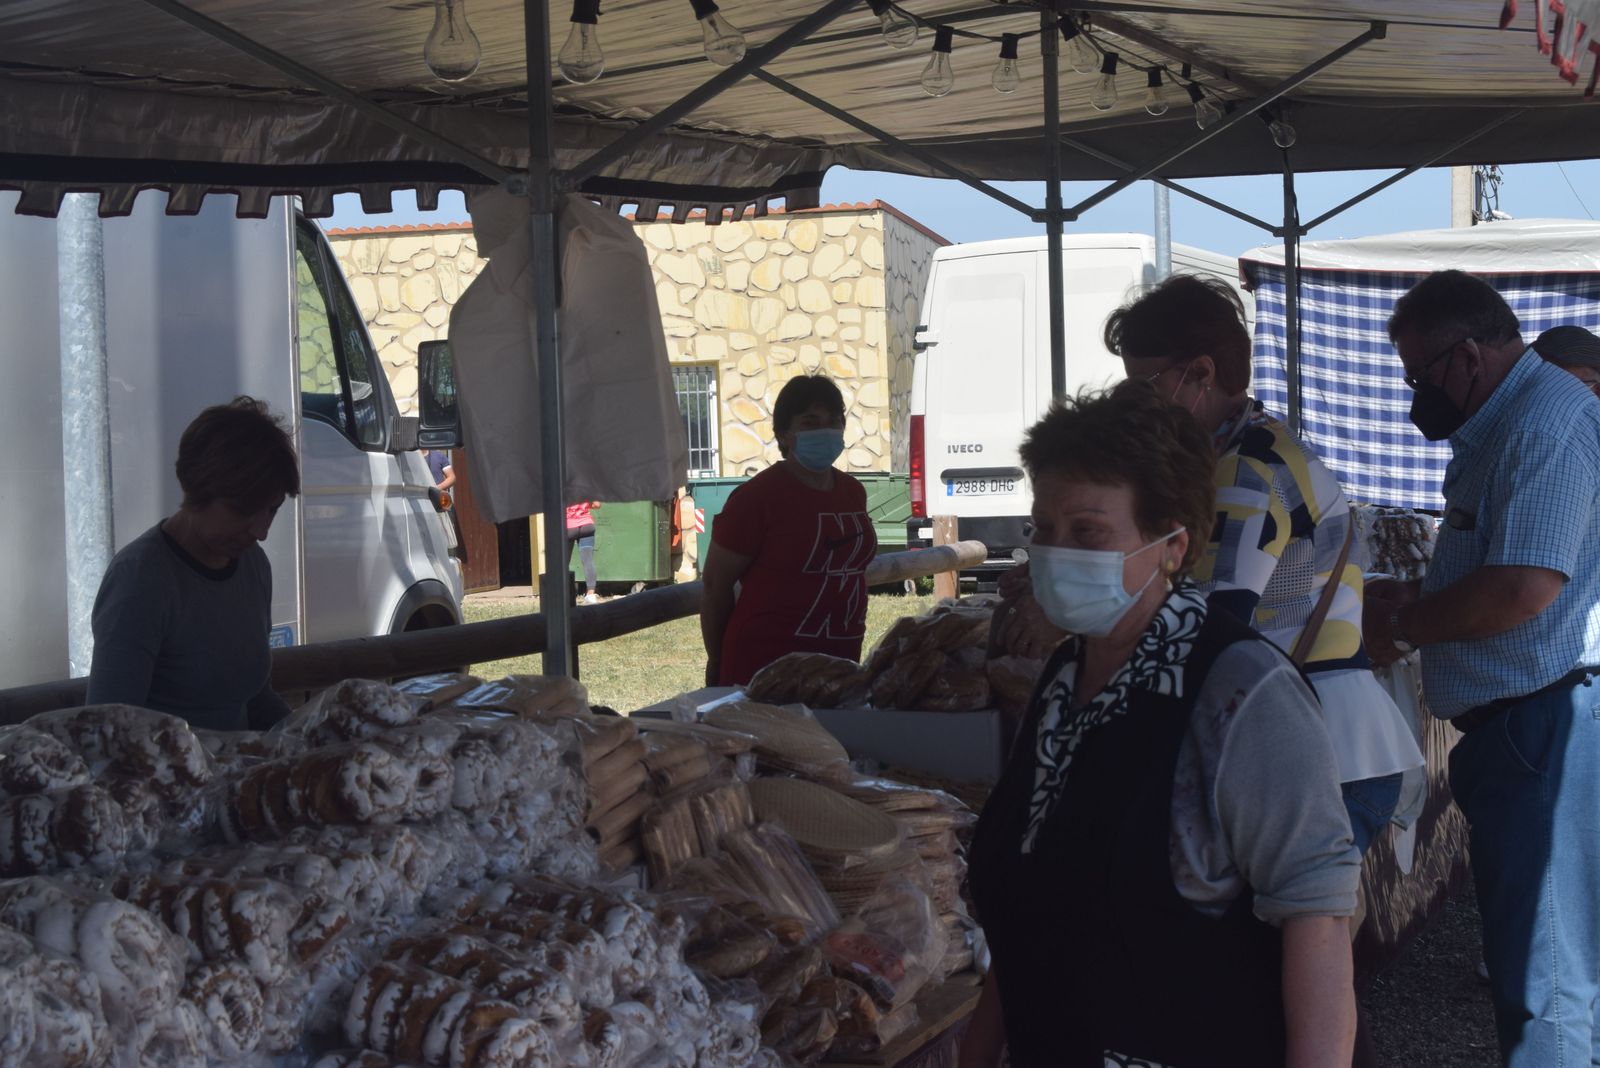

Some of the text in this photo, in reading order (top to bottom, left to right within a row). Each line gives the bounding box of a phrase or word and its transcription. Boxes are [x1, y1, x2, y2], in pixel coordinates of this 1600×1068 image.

[947, 444, 983, 454] IVECO
[955, 479, 1014, 494] 2988 DHG
